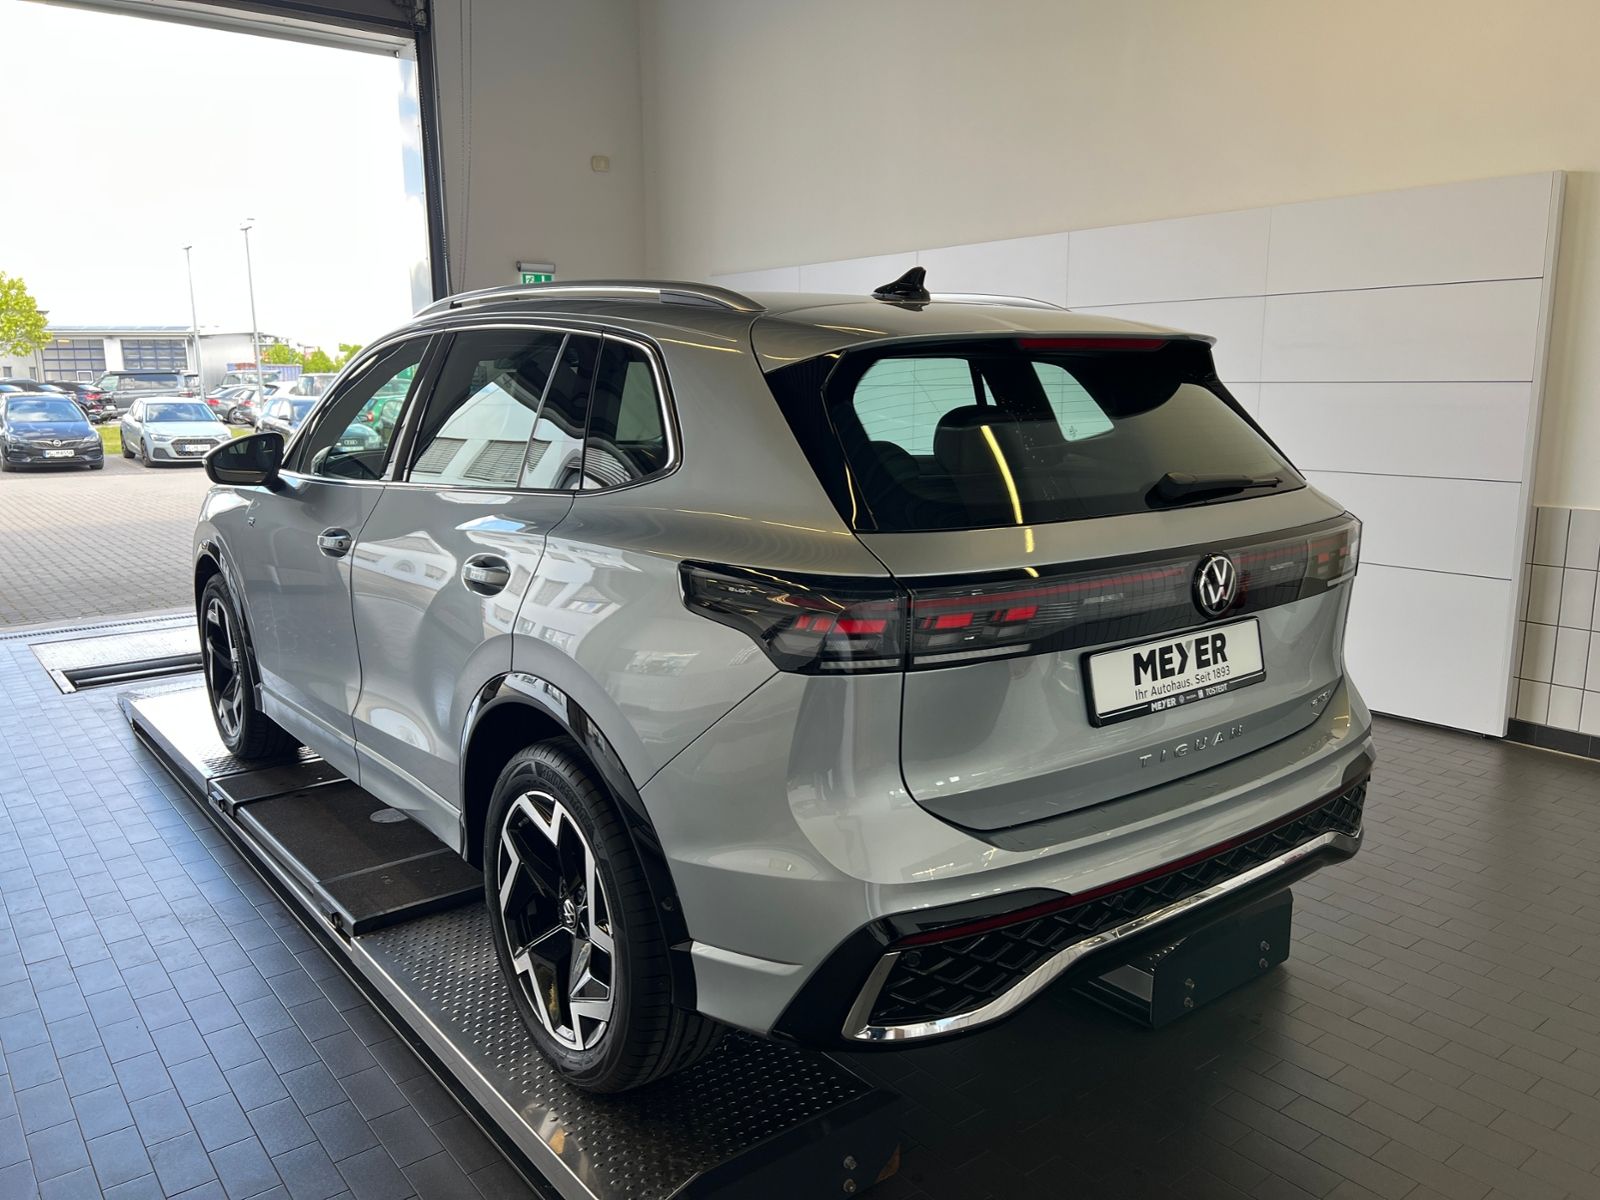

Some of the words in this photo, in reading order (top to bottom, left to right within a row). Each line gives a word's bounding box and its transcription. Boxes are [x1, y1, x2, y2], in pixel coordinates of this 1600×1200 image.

[1133, 632, 1228, 685] MEYER
[1135, 689, 1148, 701] Ihr
[1151, 679, 1193, 697] Autohaus.
[1195, 673, 1211, 685] Seit
[1213, 666, 1231, 680] 1893
[1151, 697, 1177, 712] MEYER
[1139, 724, 1243, 768] TIGUAN
